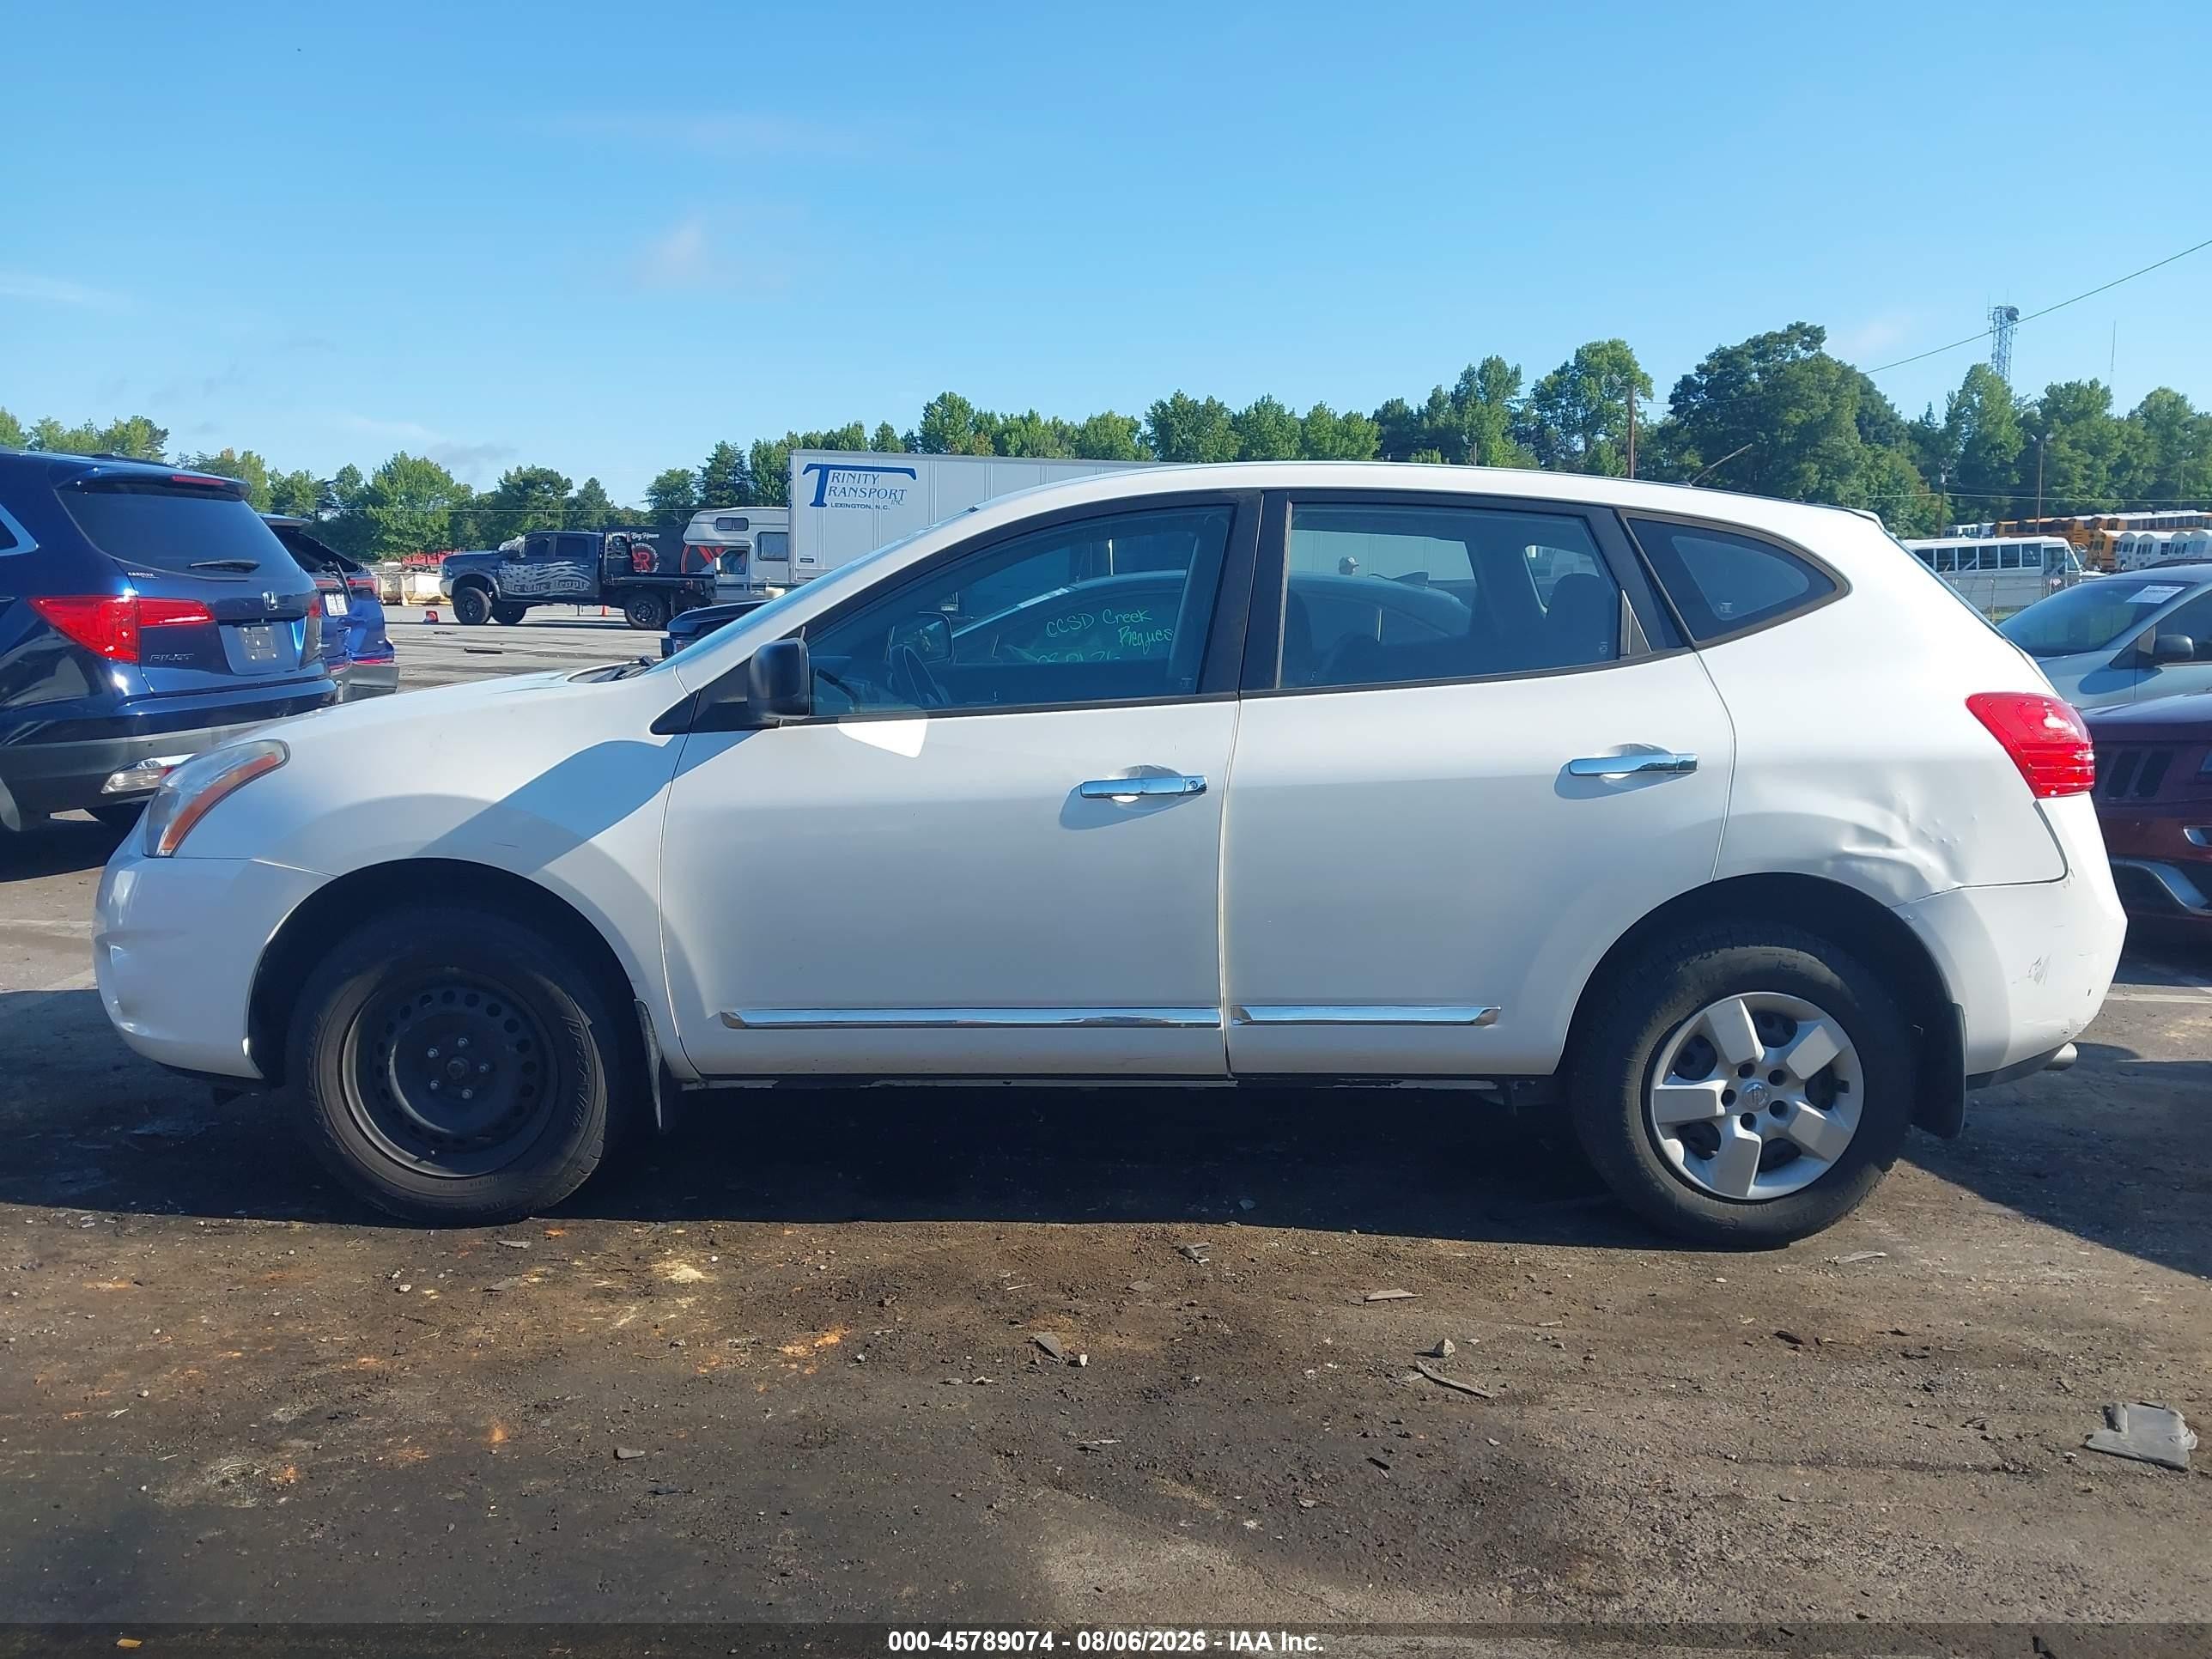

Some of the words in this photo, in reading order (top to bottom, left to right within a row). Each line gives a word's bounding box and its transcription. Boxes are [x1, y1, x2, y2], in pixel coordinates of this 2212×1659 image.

[1045, 612, 1095, 638] CCSD
[1102, 608, 1152, 625] Creek
[1117, 625, 1175, 655] Reques
